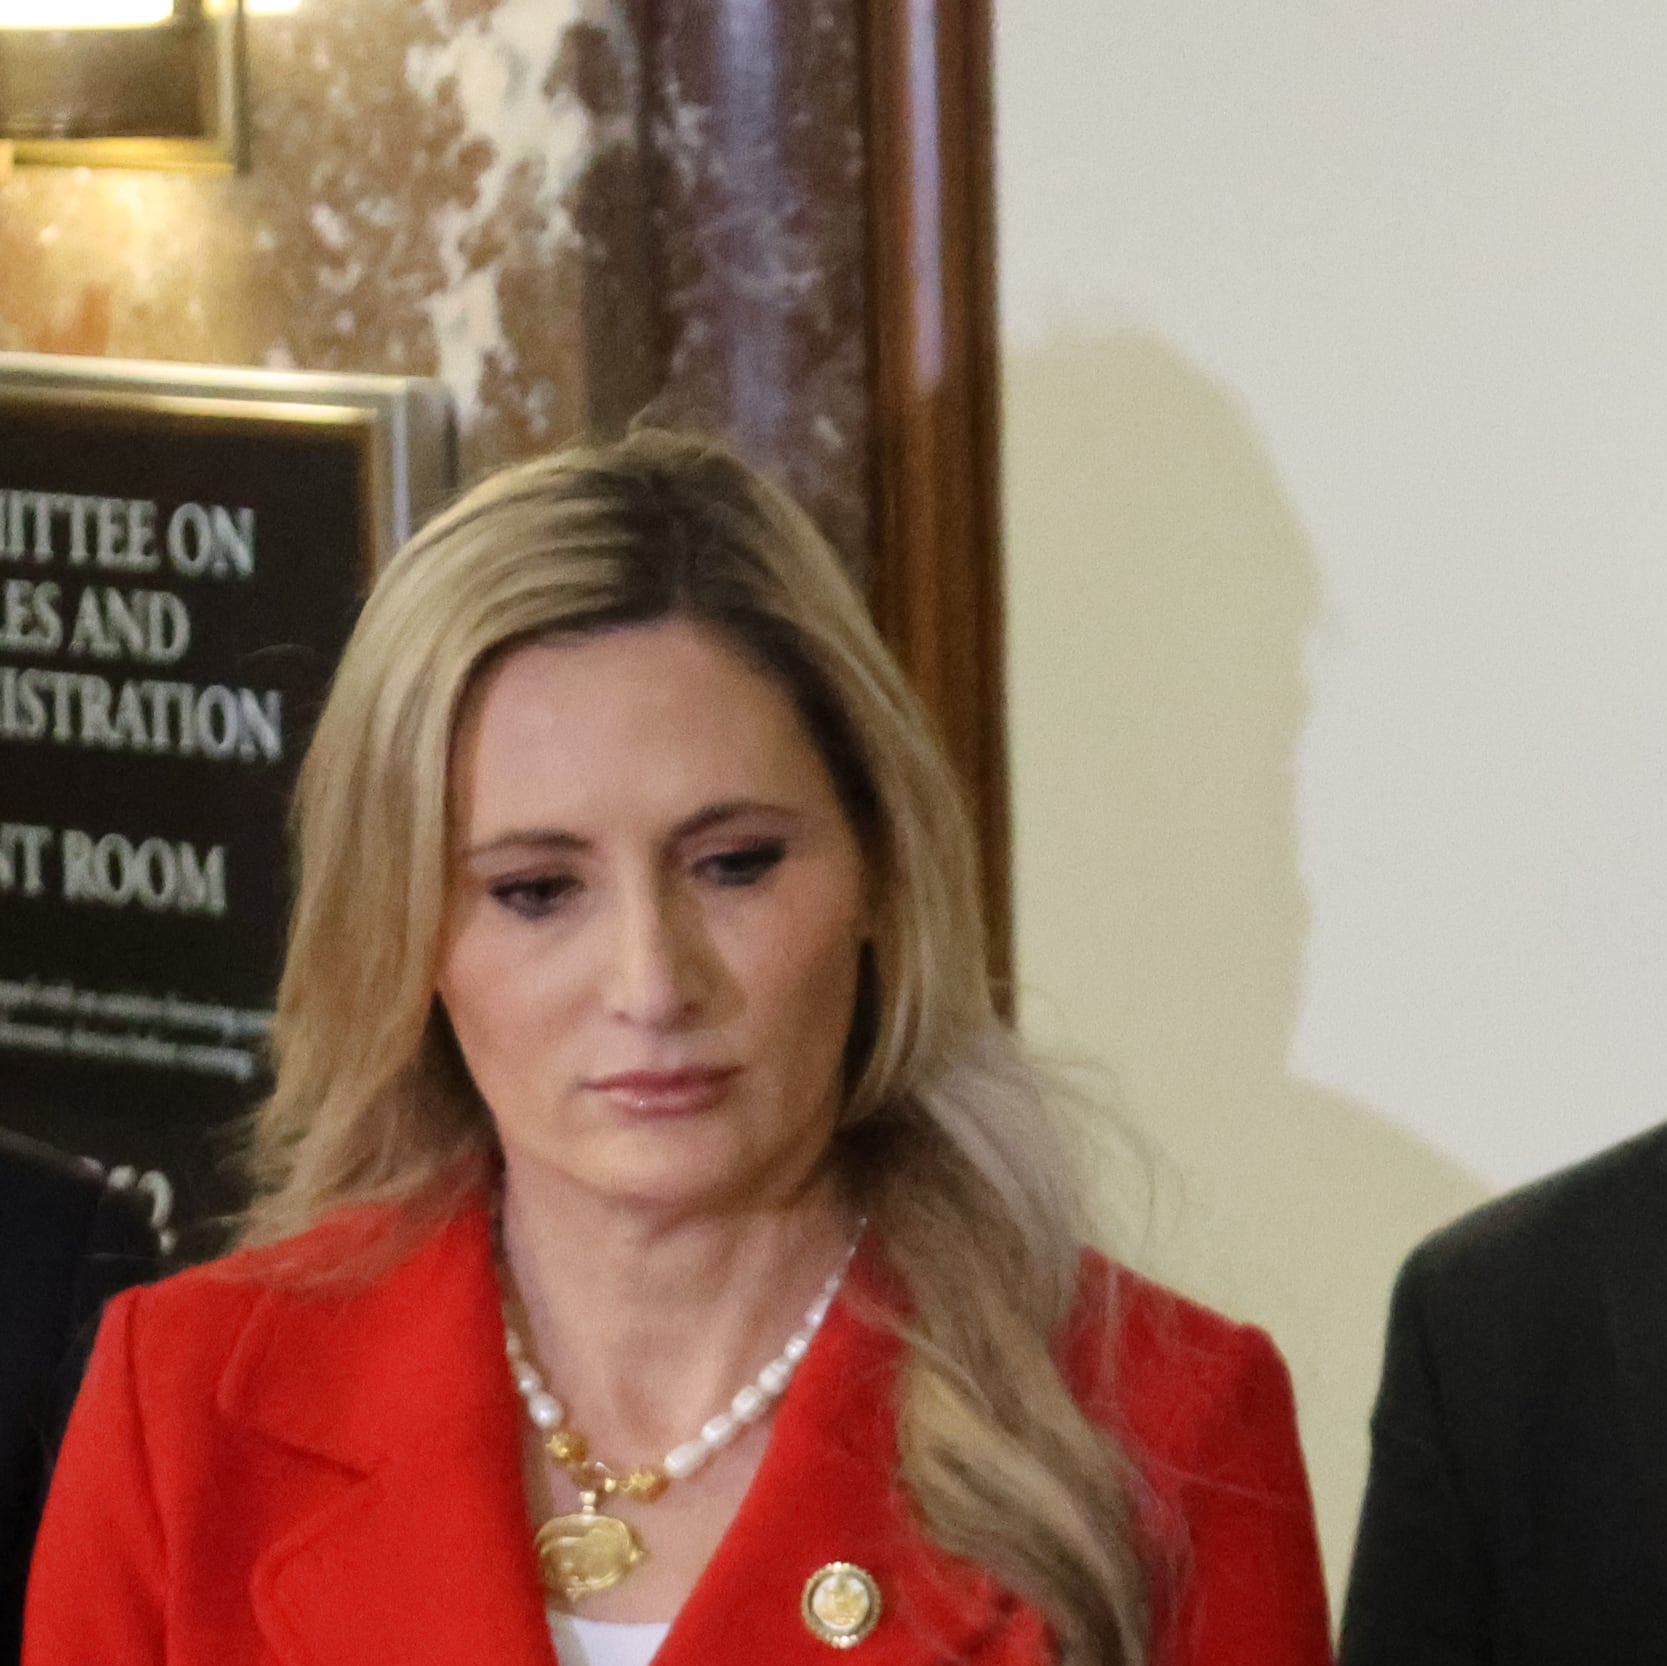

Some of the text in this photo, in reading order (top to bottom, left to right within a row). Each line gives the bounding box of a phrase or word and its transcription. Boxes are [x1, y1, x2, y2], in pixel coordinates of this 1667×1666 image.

[0, 489, 255, 577] ITTEE ON
[0, 580, 191, 663] ES AND
[63, 829, 227, 916] ROOM
